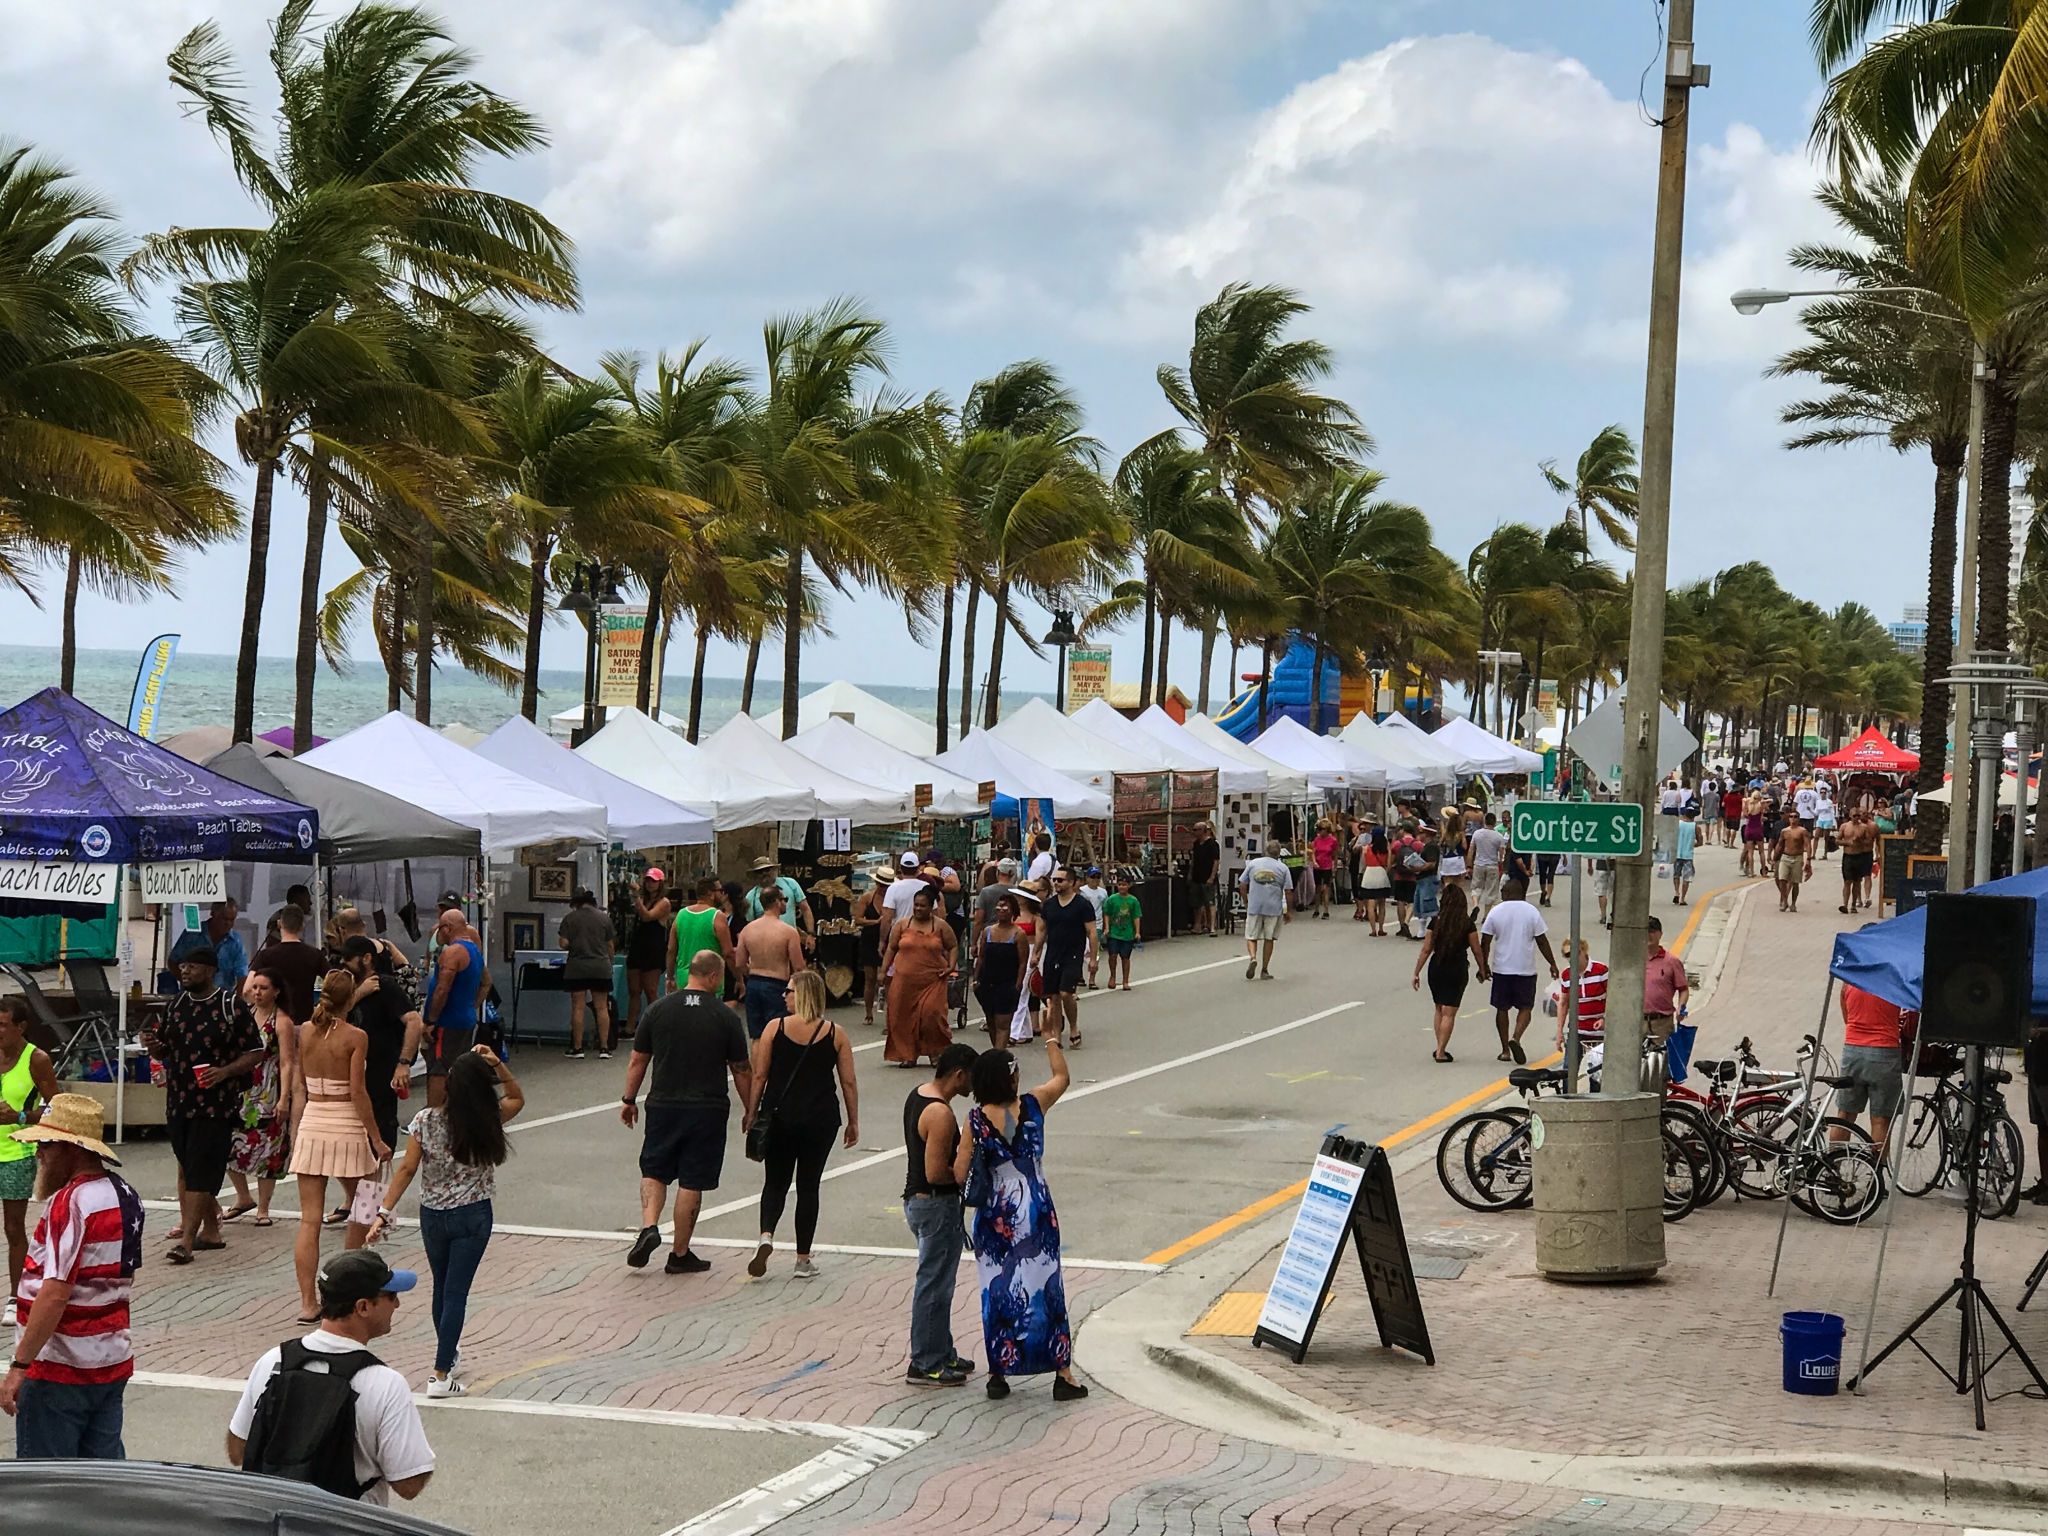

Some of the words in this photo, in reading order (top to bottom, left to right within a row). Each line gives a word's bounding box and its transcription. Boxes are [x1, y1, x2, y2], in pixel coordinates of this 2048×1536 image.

[613, 658, 633, 667] MAY
[1, 732, 69, 758] TABLE
[86, 728, 151, 753] OCTABLE
[1838, 760, 1865, 768] FLORIDA
[1865, 761, 1898, 769] PANTHERS
[197, 820, 228, 836] Beach
[229, 818, 263, 834] Tables
[1517, 812, 1598, 843] Cortez
[1610, 815, 1637, 844] St
[0, 860, 105, 898] achTables
[145, 861, 219, 897] BeachTables
